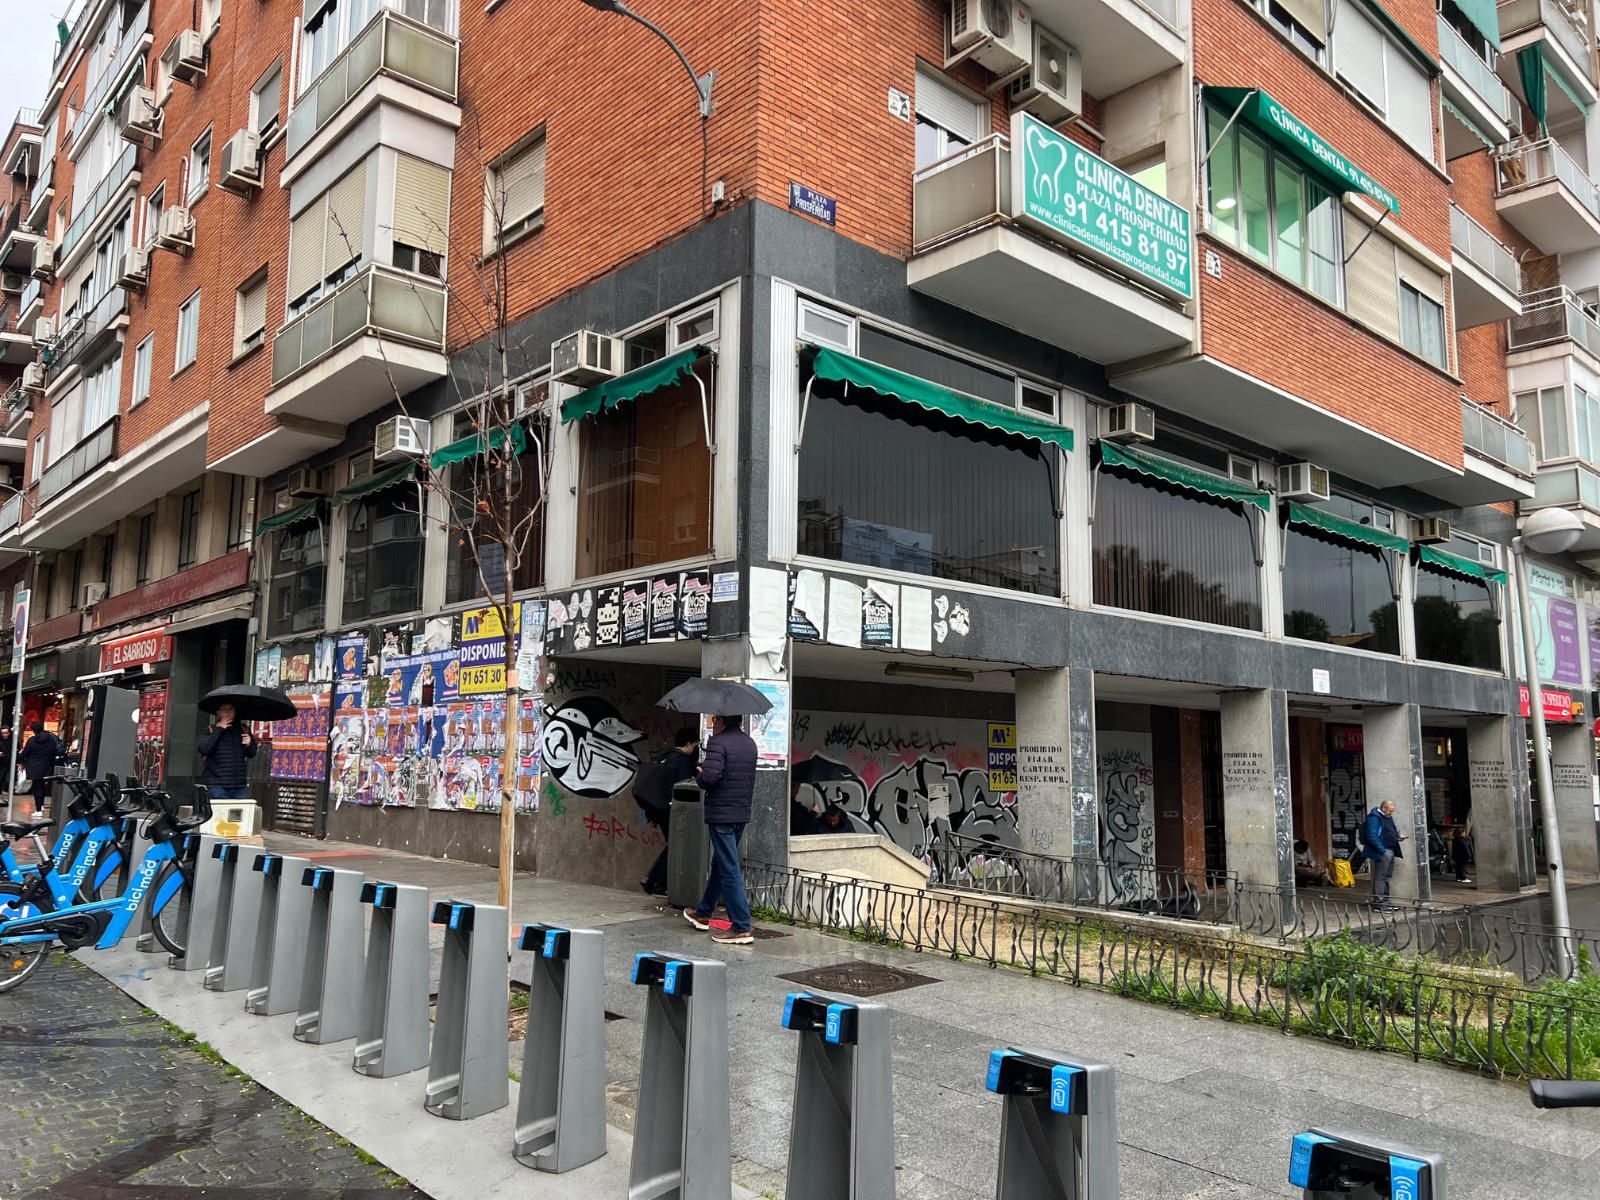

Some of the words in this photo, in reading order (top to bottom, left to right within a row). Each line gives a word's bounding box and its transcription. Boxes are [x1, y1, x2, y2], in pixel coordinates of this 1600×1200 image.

[1312, 138, 1348, 176] DENTAL
[1349, 167, 1359, 184] 91
[807, 191, 828, 206] PLAZA
[1074, 152, 1132, 206] CLINICA
[1135, 187, 1187, 237] DENTAL
[795, 196, 831, 220] PROSPERIDAD
[1076, 180, 1112, 213] PLAZA
[1114, 201, 1187, 252] PROSPERIDAD
[1063, 192, 1088, 225] 91
[1096, 212, 1133, 248] 415
[1138, 233, 1159, 263] 81
[1165, 249, 1188, 275] 97
[1029, 201, 1187, 290] www.clinicadentalplazaprosperidad.com
[656, 595, 672, 608] NOS
[688, 595, 705, 607] NOS
[626, 605, 642, 618] NOS
[868, 604, 886, 617] NOS
[113, 646, 121, 664] EL
[122, 638, 157, 662] SABROSO
[463, 671, 472, 685] 91
[474, 670, 489, 684] 651
[492, 669, 501, 683] 30
[1020, 745, 1062, 753] PROHIBIDO
[1022, 765, 1066, 773] CARTELES
[992, 772, 1002, 784] 91
